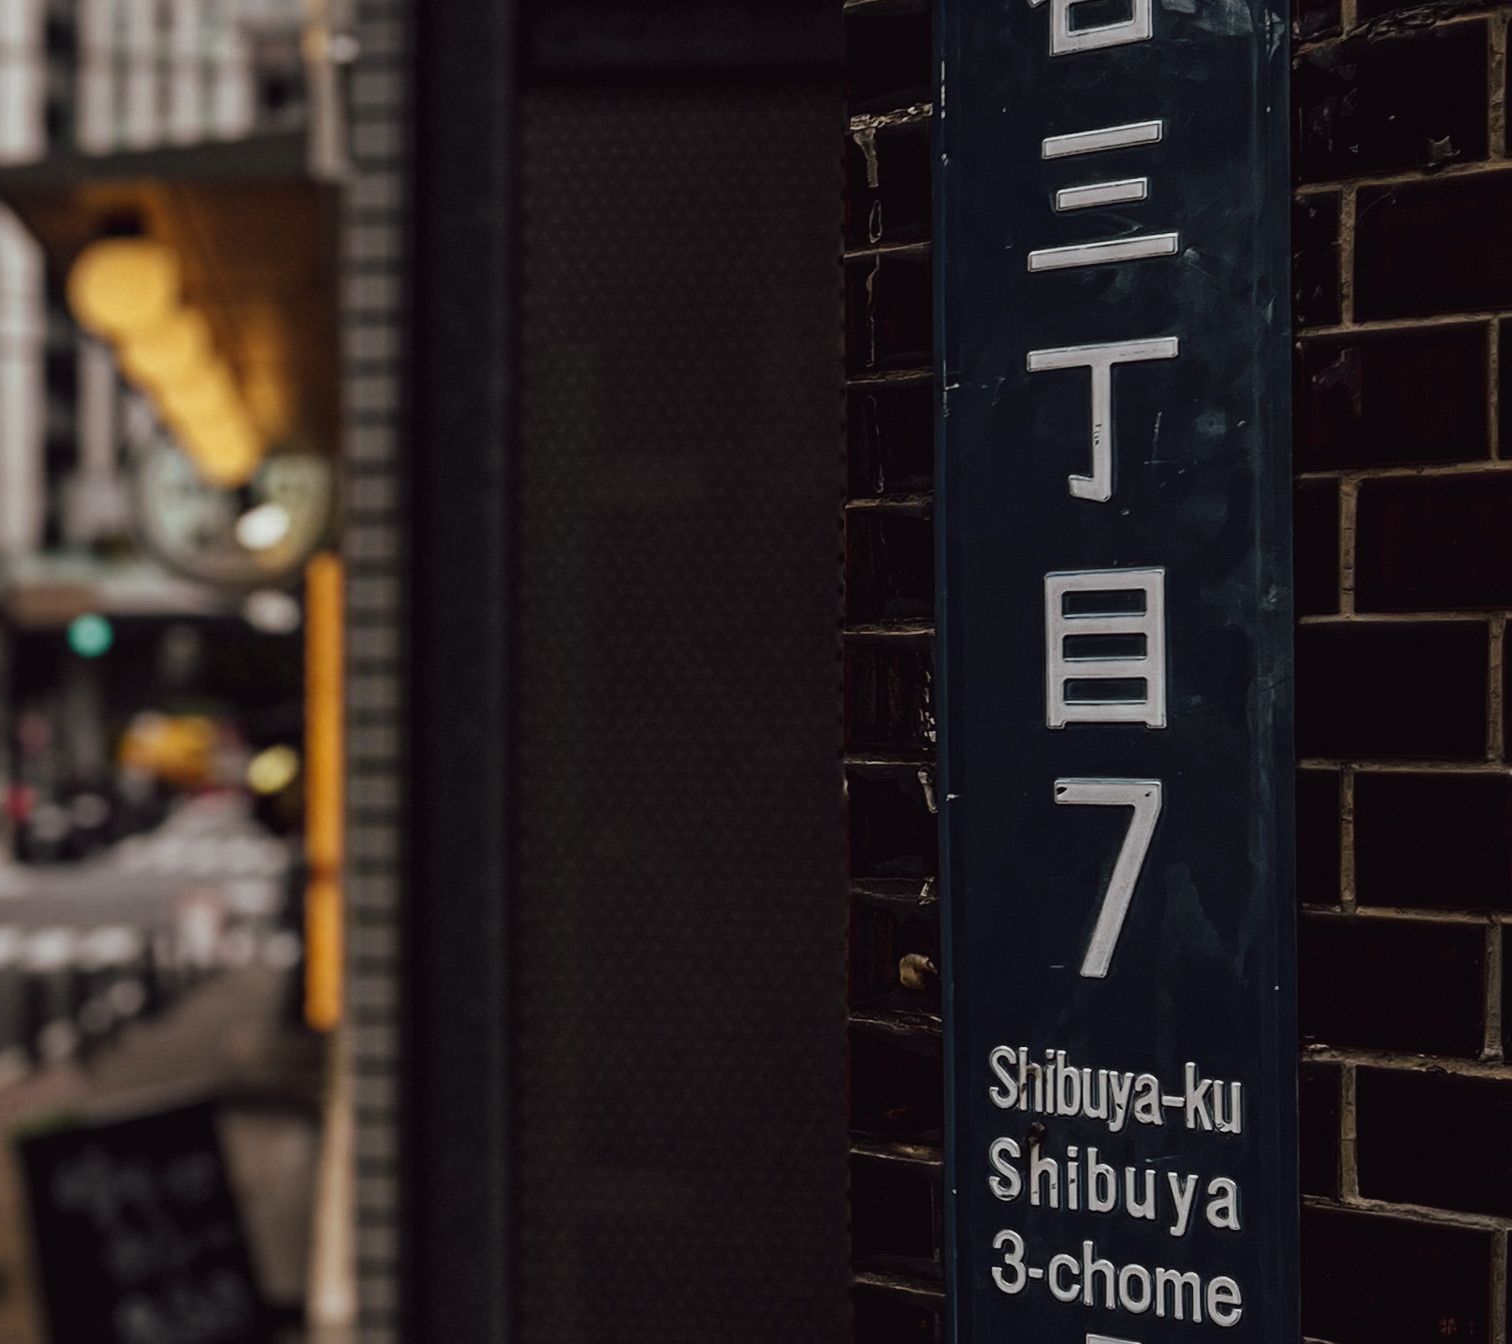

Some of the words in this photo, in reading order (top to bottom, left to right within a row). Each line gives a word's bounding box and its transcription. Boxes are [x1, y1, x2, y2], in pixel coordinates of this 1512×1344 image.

[988, 1044, 1244, 1134] Shibuya-ku
[988, 1136, 1243, 1238] Shibuya
[990, 1228, 1245, 1329] 3-chome
